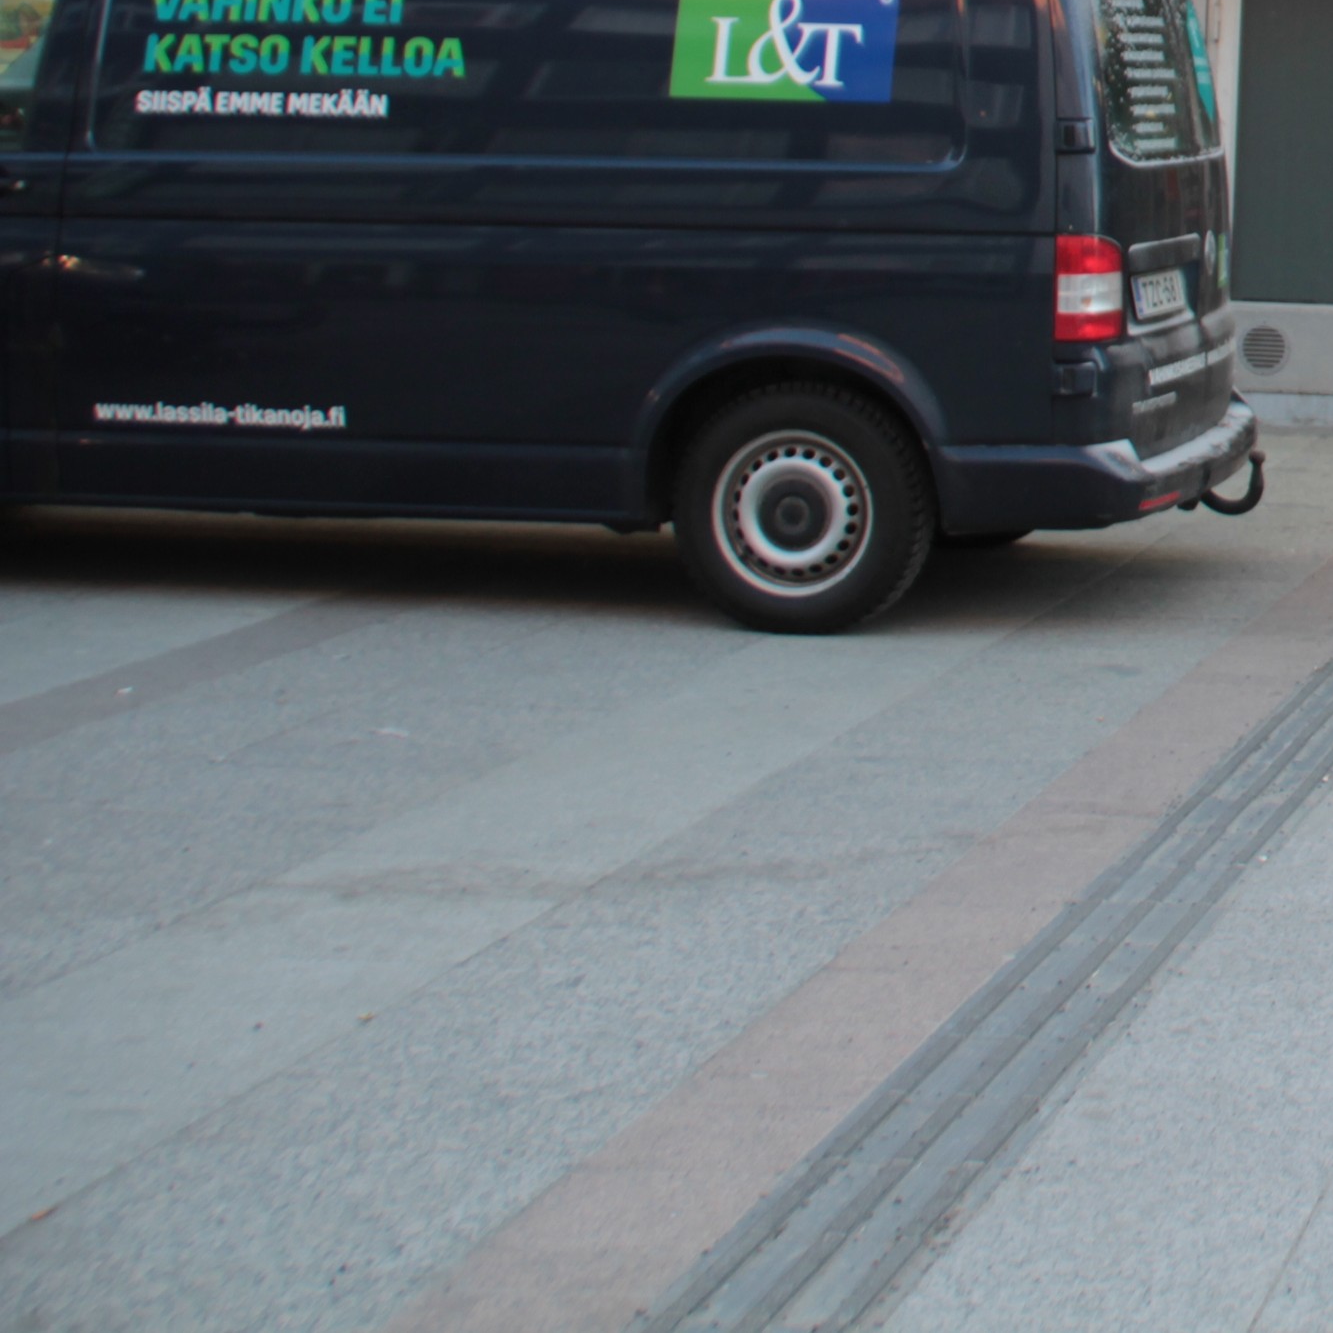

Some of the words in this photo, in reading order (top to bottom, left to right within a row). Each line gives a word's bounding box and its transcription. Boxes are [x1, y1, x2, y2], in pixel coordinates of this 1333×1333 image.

[143, 32, 289, 76] KATSO
[300, 35, 466, 79] KELLOA
[136, 87, 211, 114] SIISPÄ
[215, 91, 283, 116] EMME
[286, 89, 388, 118] MEKÄÄN
[94, 399, 346, 431] www.lassila-tikanoja.fi
